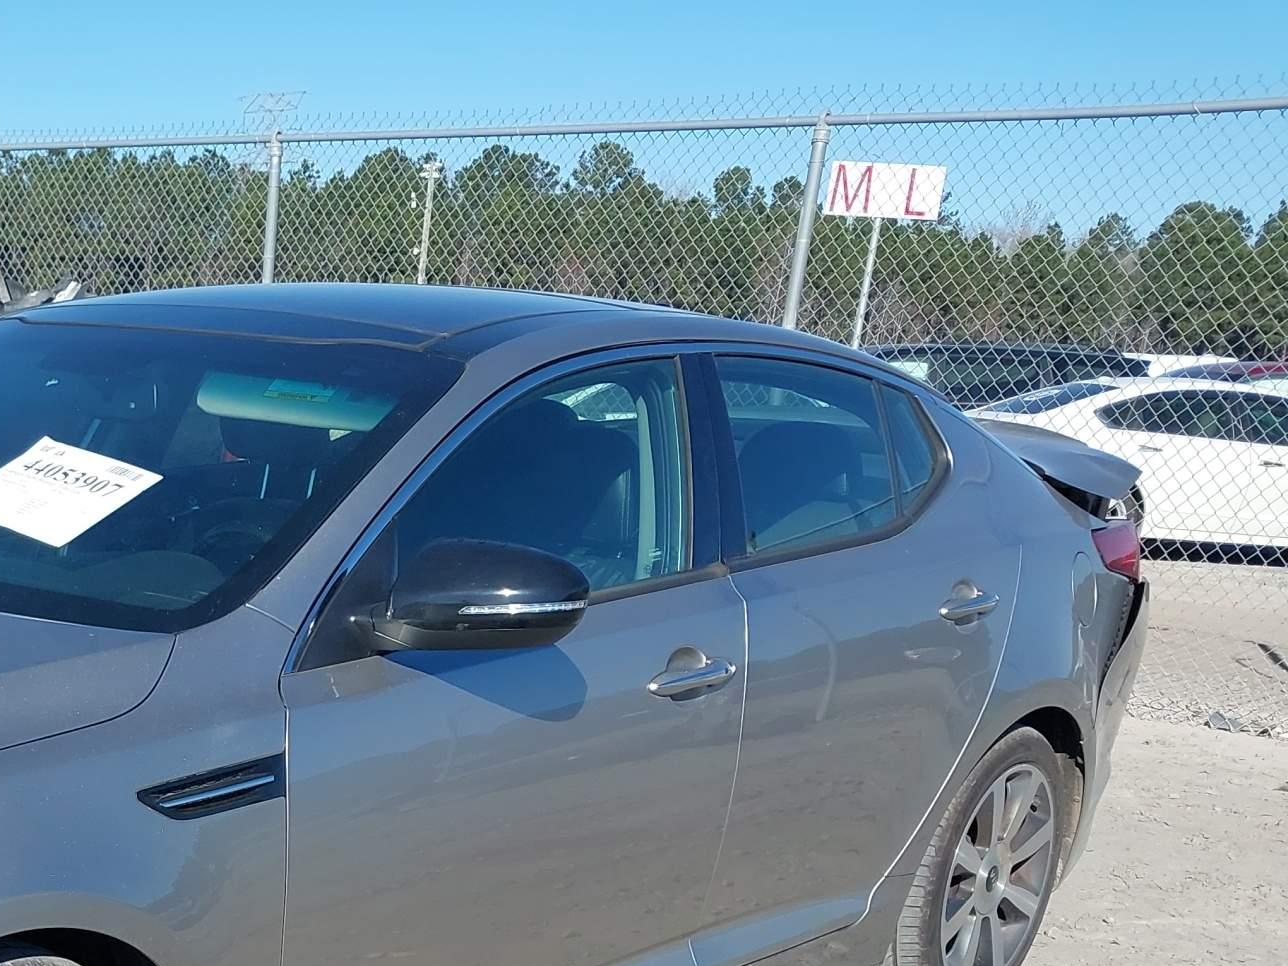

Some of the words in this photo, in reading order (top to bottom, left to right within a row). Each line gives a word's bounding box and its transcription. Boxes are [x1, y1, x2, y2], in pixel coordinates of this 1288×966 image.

[829, 164, 874, 213] M
[904, 167, 926, 217] L
[23, 459, 126, 497] 44053907
